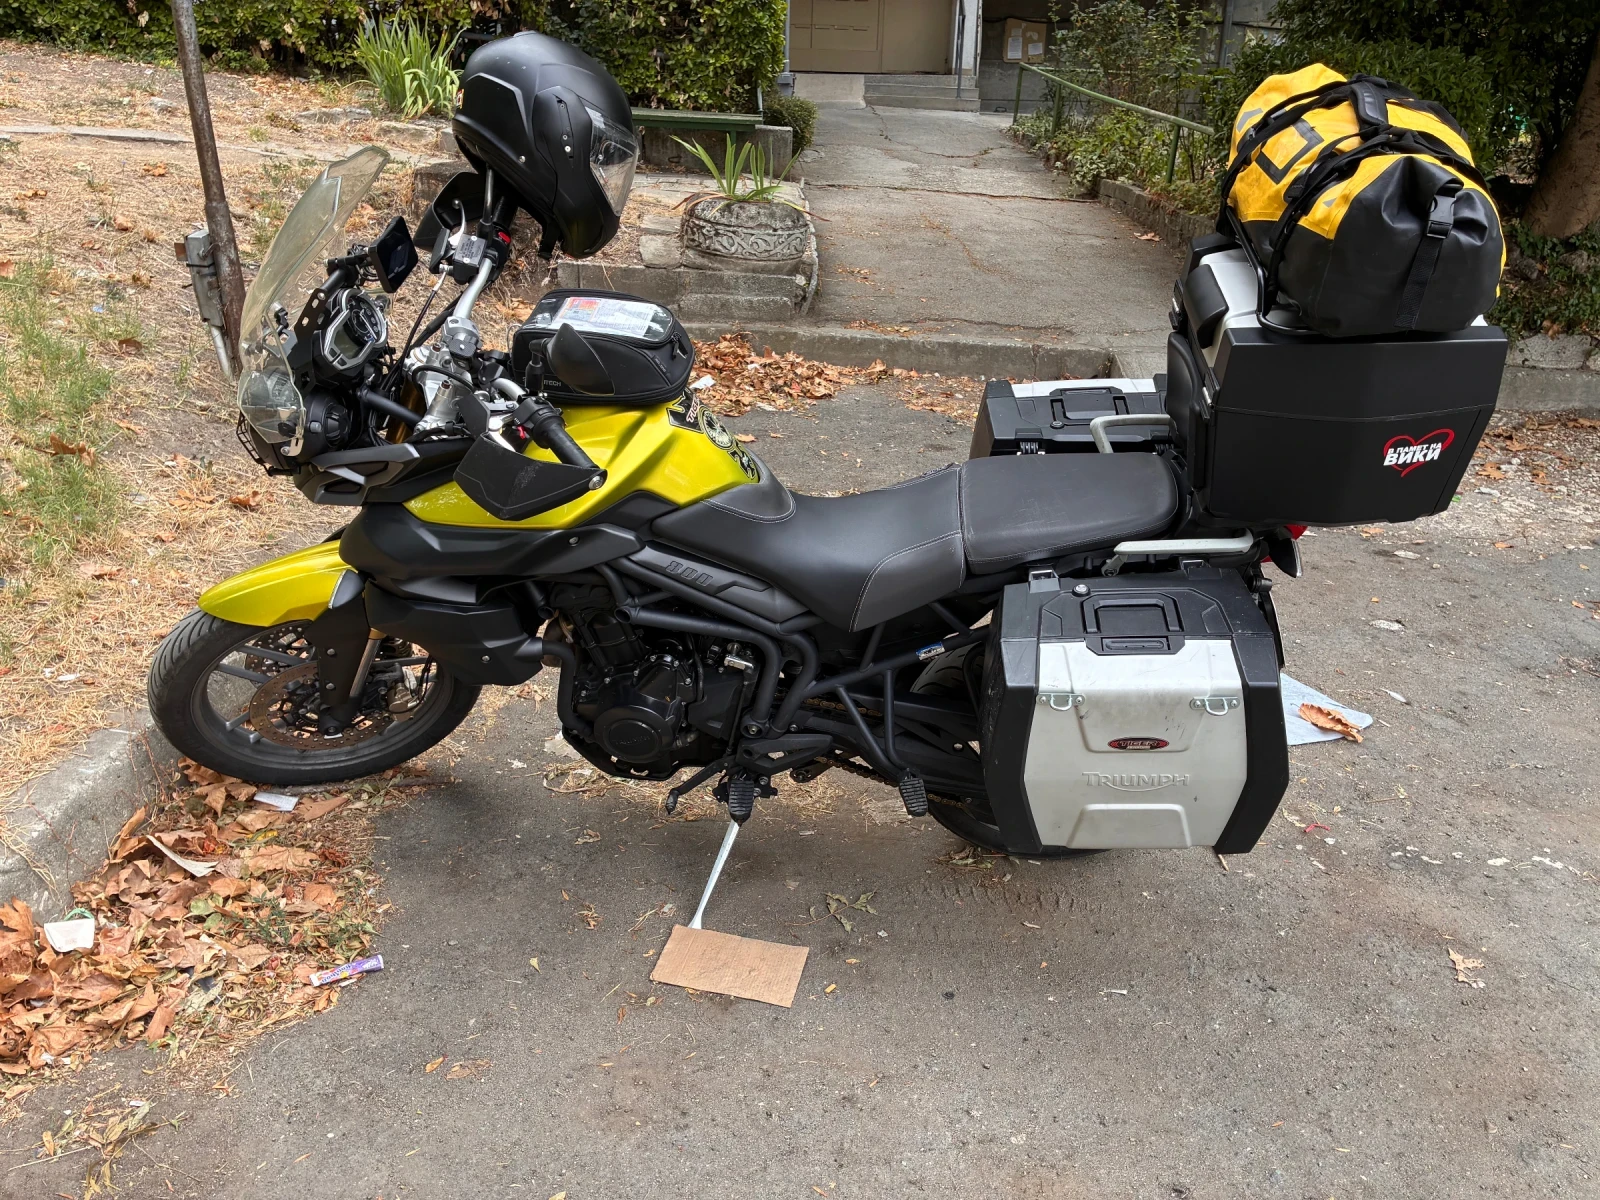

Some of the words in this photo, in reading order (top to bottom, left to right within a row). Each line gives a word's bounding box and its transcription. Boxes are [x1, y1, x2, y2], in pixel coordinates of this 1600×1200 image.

[1383, 448, 1442, 466] ВИКИ
[1396, 444, 1429, 454] ПАМЕТ
[665, 560, 714, 587] 800
[1081, 771, 1190, 790] TRIUMPH
